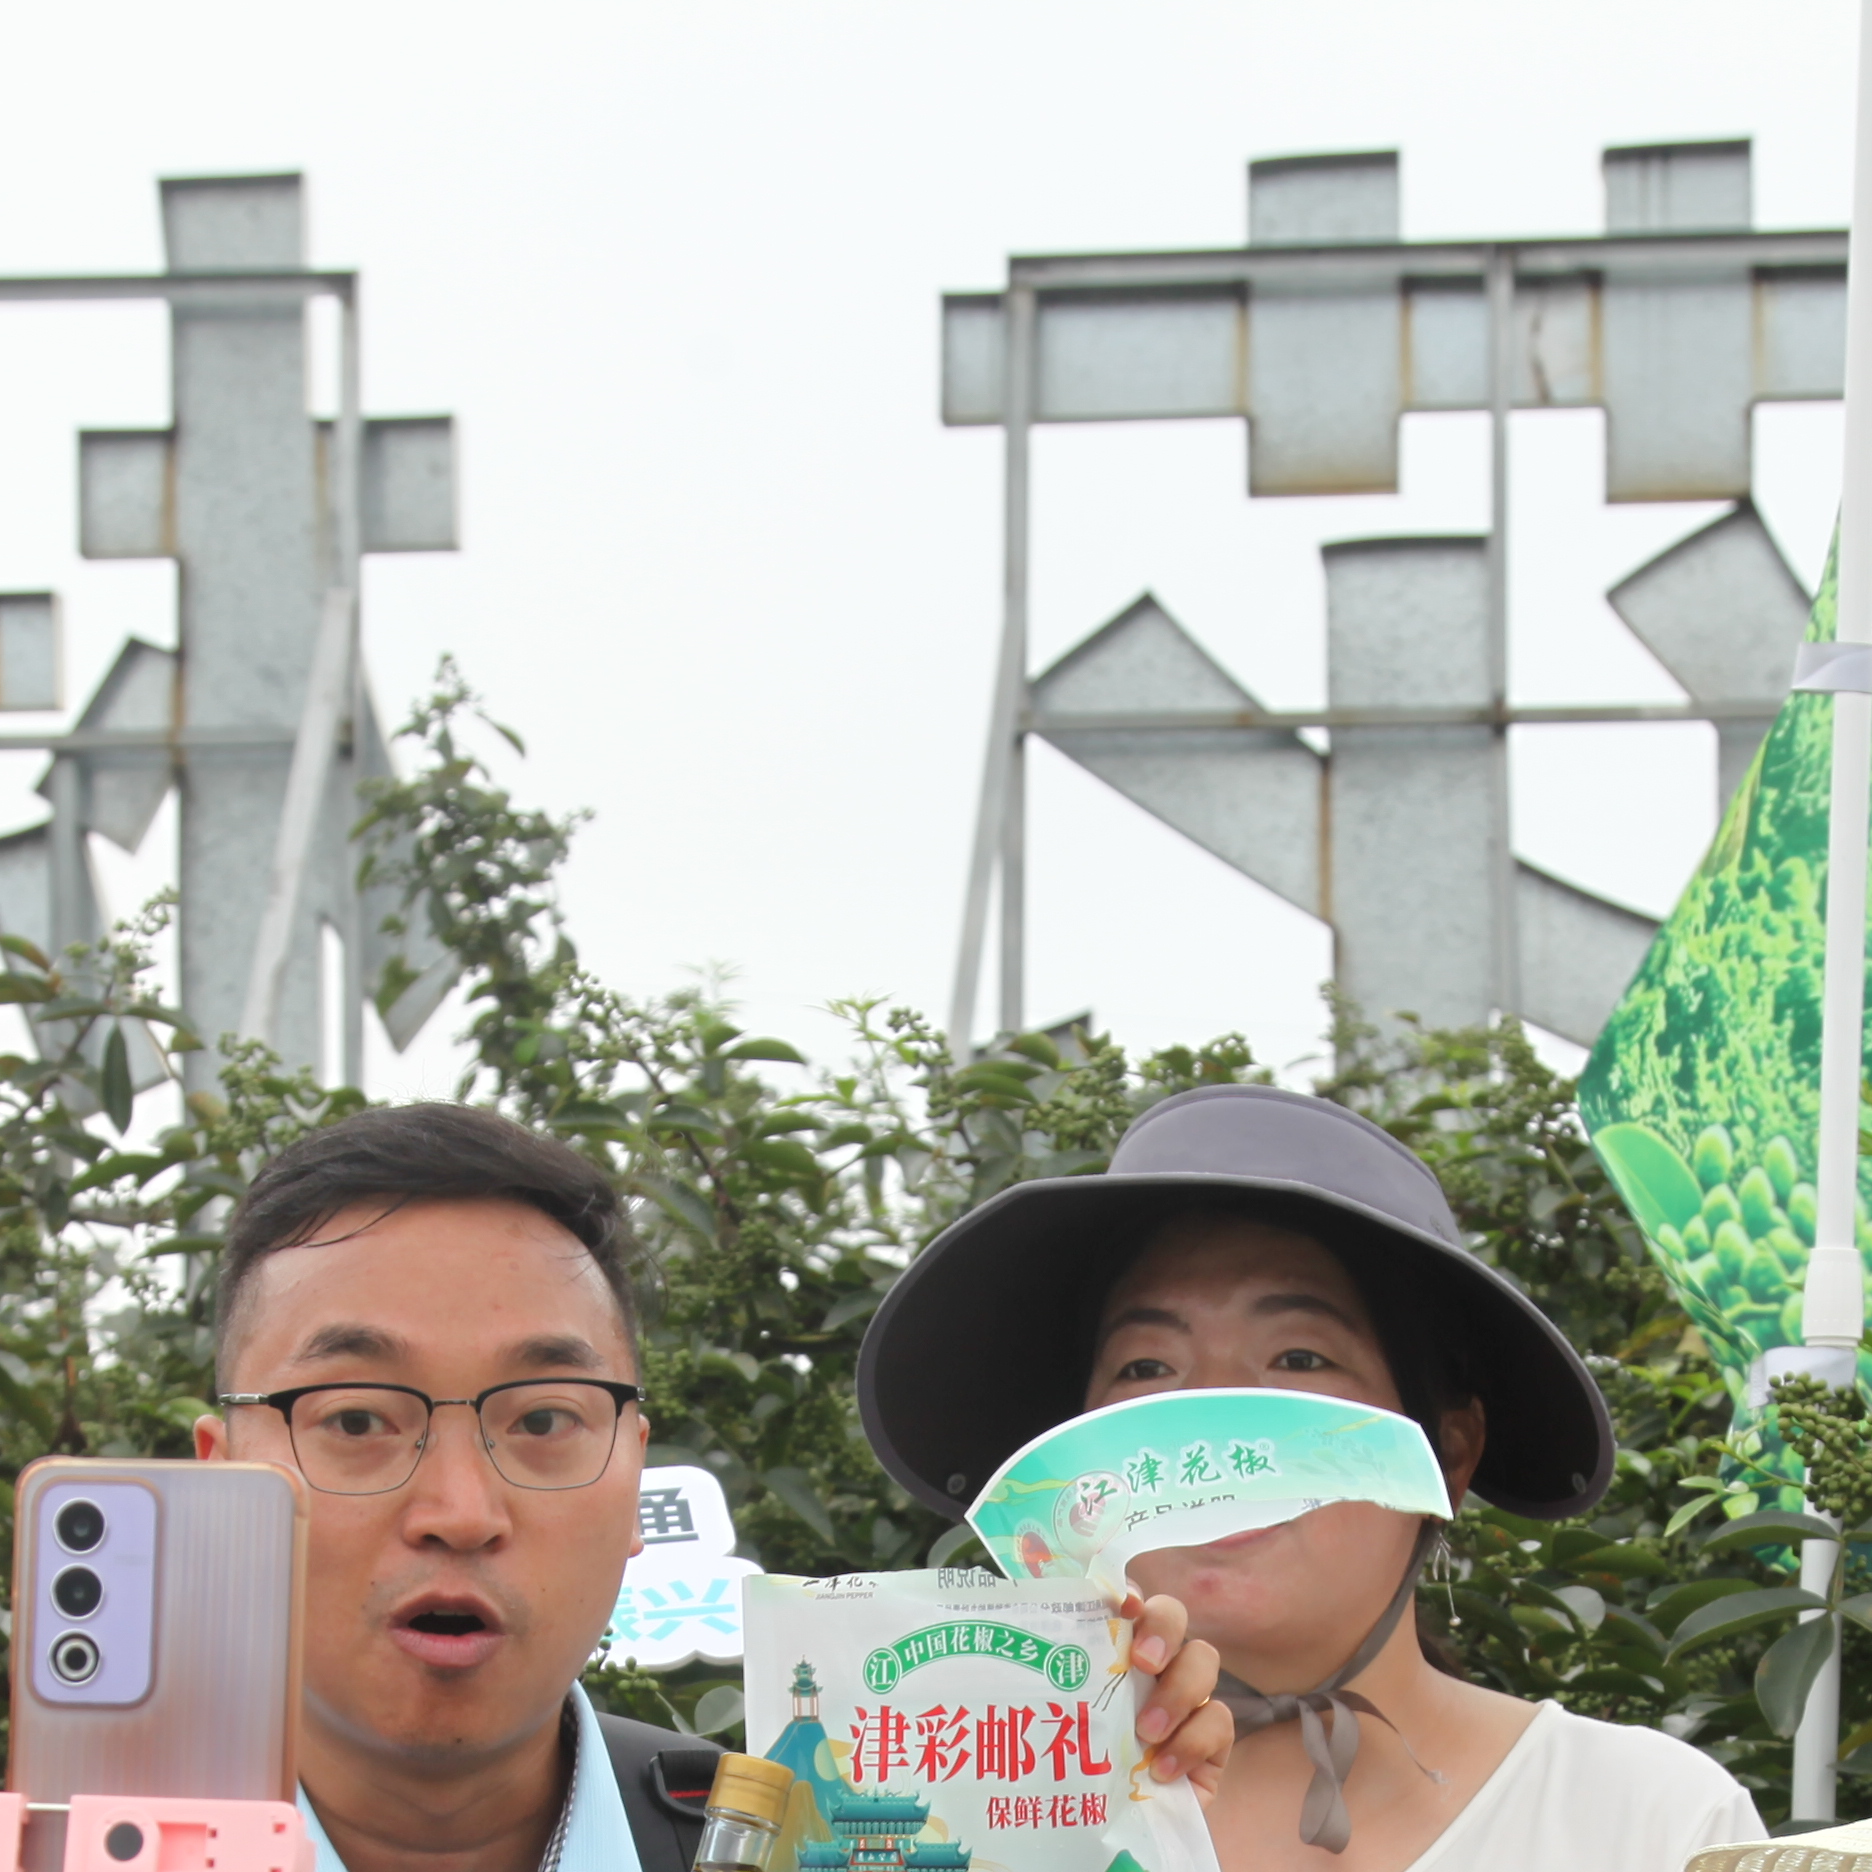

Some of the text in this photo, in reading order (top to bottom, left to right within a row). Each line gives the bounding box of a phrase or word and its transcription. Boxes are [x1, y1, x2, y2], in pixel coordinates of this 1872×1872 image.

[1078, 1443, 1276, 1516] 江津花椒
[846, 1591, 874, 1599] PEPPER
[903, 1626, 1041, 1665] 中国花椒之乡
[869, 1655, 895, 1688] 江
[1055, 1652, 1085, 1684] 津
[849, 1700, 1112, 1784] 津彩邮礼
[986, 1792, 1108, 1831] 保鲜花椒
